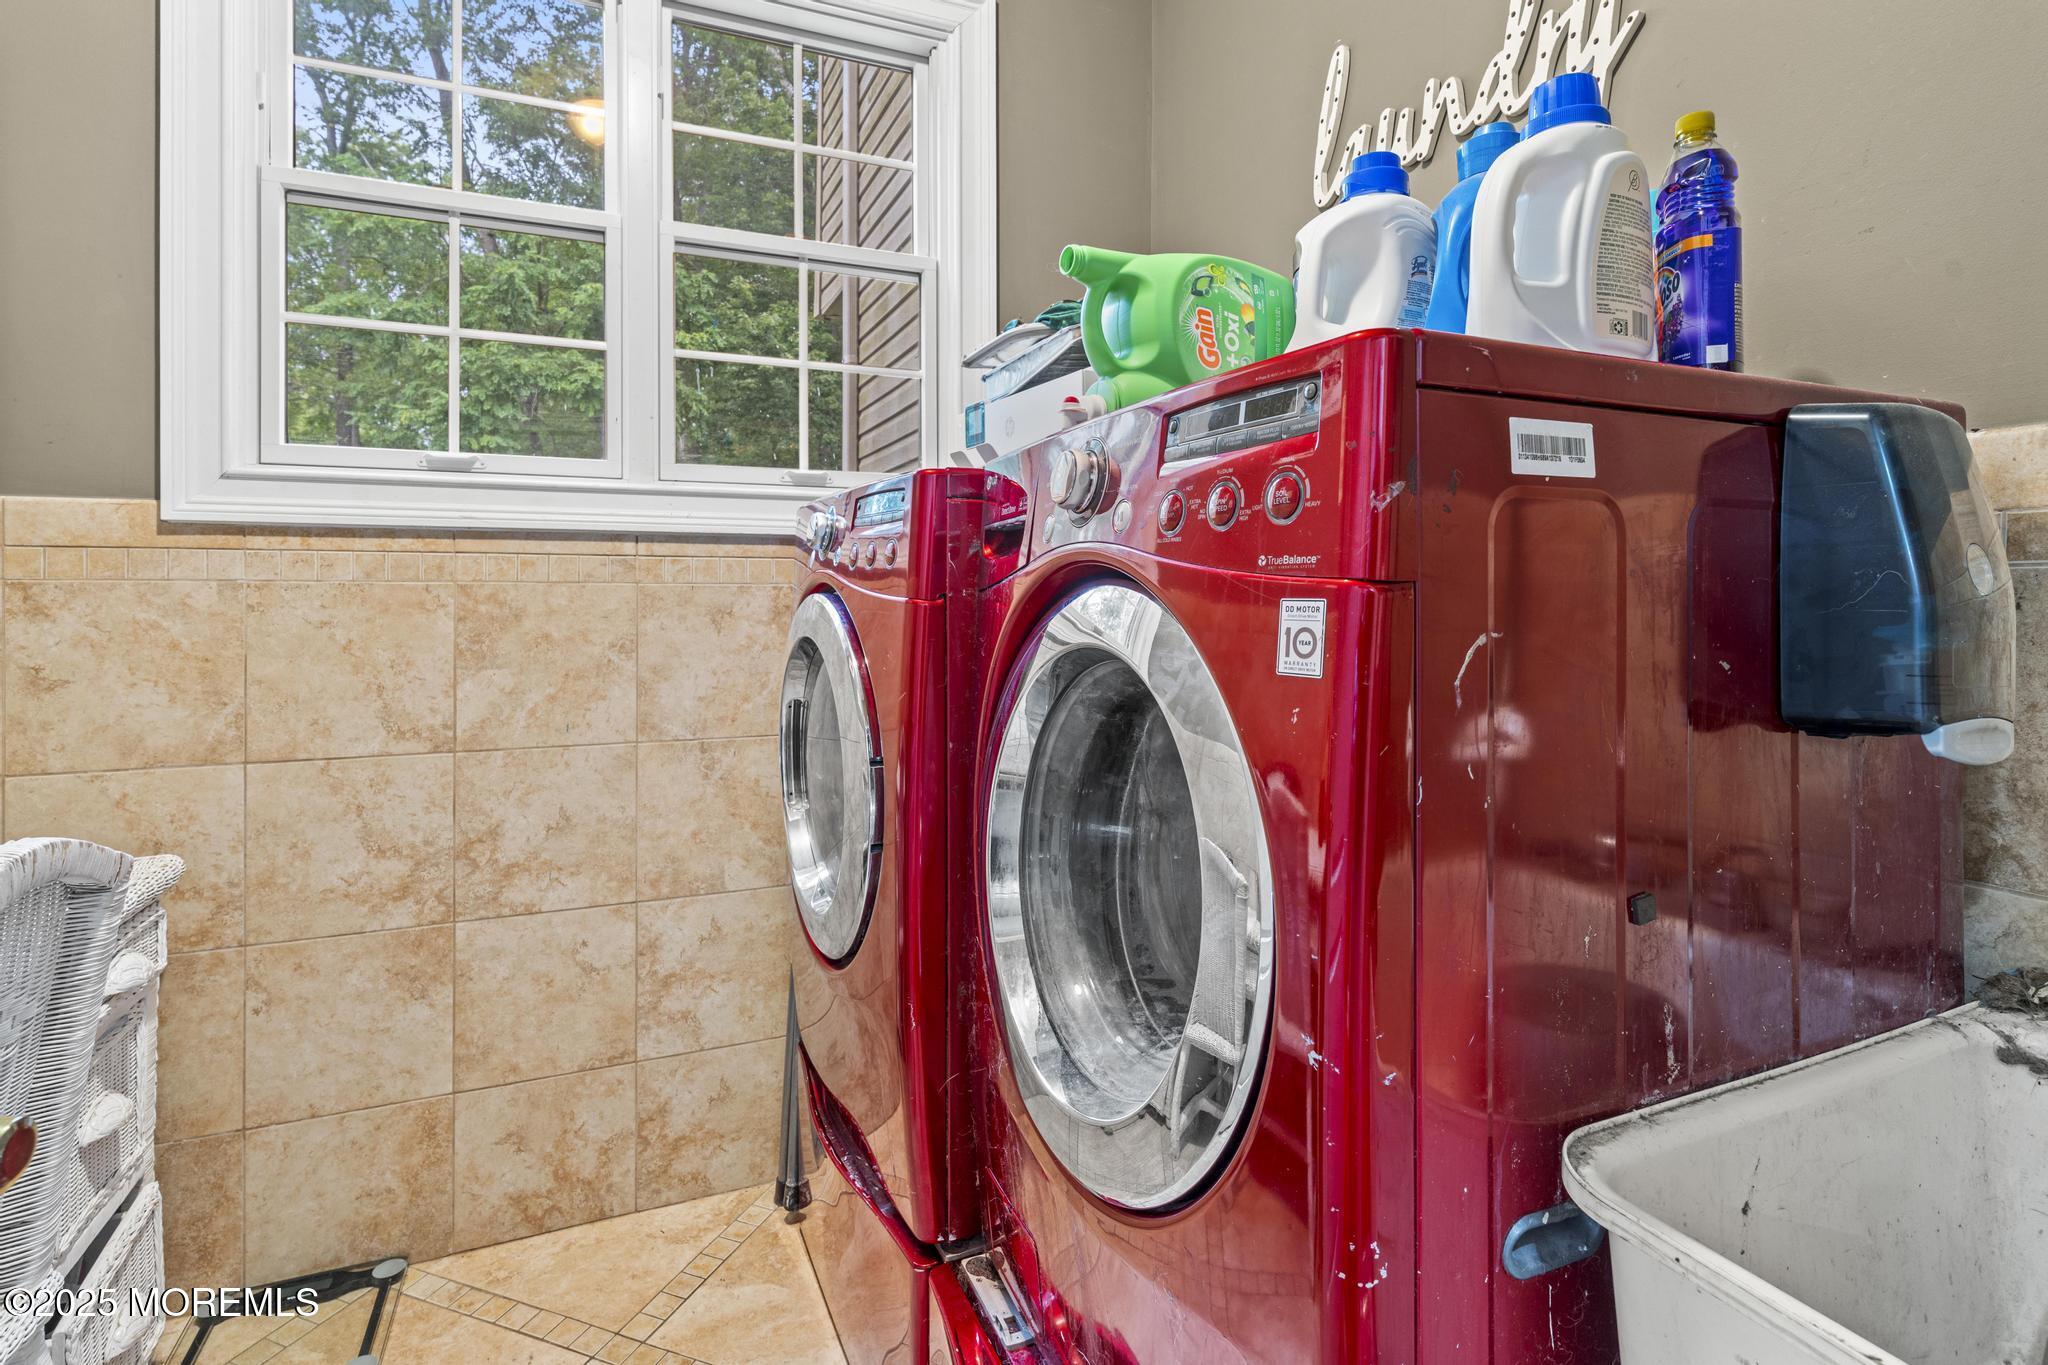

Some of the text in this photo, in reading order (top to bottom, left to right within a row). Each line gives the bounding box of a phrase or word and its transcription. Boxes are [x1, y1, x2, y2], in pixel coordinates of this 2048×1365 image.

[1195, 307, 1222, 370] Gain
[1273, 497, 1291, 505] LEVEL
[1267, 555, 1317, 565] TrueBalance
[1285, 605, 1321, 614] DD MOTOR
[1284, 626, 1318, 660] 10
[1298, 639, 1312, 647] YEAR
[1284, 660, 1317, 668] WARRANTY
